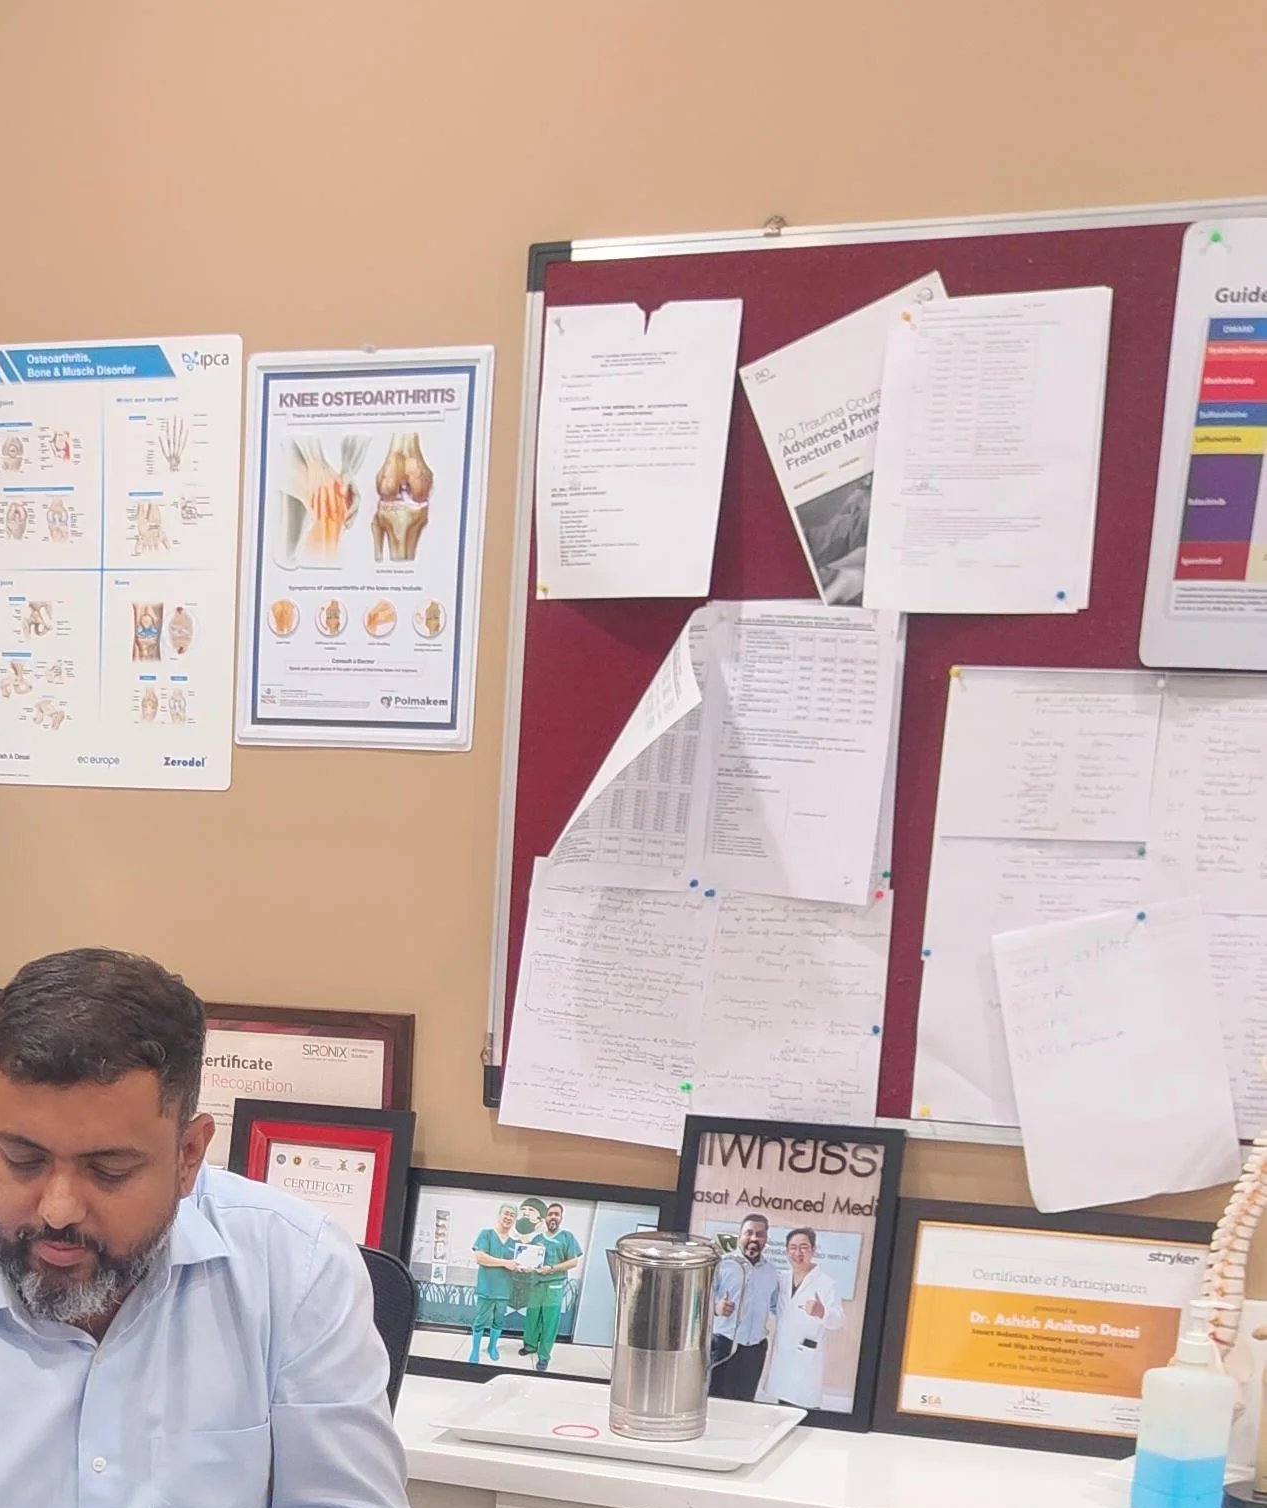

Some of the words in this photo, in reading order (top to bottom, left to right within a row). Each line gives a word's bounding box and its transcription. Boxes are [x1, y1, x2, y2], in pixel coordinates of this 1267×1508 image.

[26, 352, 91, 364] Osteoarthritis,
[27, 367, 51, 378] Bone
[53, 367, 61, 377] &
[62, 366, 95, 377] Muscle
[97, 364, 137, 376] Disorder
[279, 392, 318, 408] KNEE
[322, 388, 456, 406] OSTEOARTHRITIS
[798, 406, 845, 434] Trauma
[782, 418, 848, 458] Advanced
[785, 439, 842, 471] Fracture
[164, 757, 206, 768] Zerodol
[302, 1043, 348, 1059] SIRONIX
[201, 1054, 273, 1071] ertificate
[212, 1073, 293, 1094] Recognition
[284, 1177, 354, 1195] CERTIFICATE
[736, 1186, 826, 1214] Advanced
[1147, 1251, 1200, 1266] stryker
[973, 1269, 1041, 1286] Certificate
[1045, 1272, 1057, 1287] of
[1062, 1275, 1147, 1295] Participation
[969, 1312, 990, 1324] Dr.
[995, 1312, 1041, 1330] Ashish
[1044, 1318, 1096, 1335] Anilrao
[1099, 1323, 1141, 1339] Desai
[920, 1395, 941, 1405] SEA
